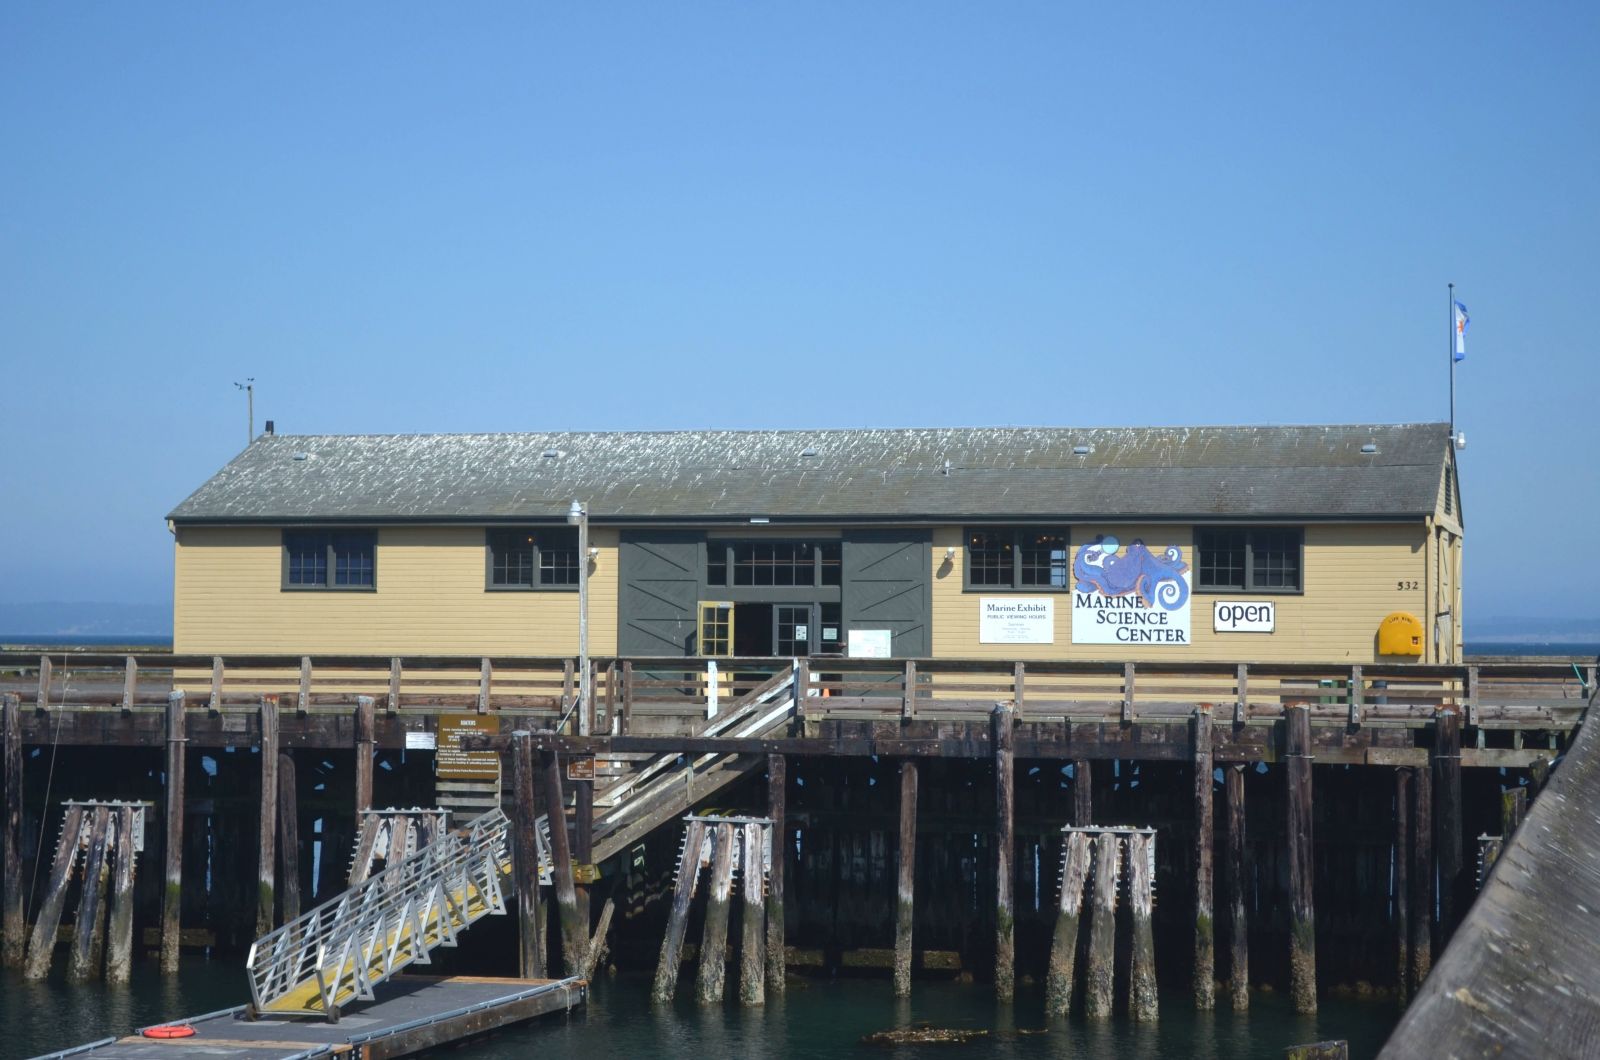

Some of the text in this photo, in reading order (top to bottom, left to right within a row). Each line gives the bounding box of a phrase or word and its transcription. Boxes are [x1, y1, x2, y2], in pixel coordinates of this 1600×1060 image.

[1397, 581, 1419, 590] 532
[987, 603, 1046, 612] Marine Exhibit
[1075, 593, 1144, 609] MARINE
[1096, 610, 1168, 625] SCIENCE
[1219, 605, 1271, 628] open
[1116, 627, 1186, 642] CENTER
